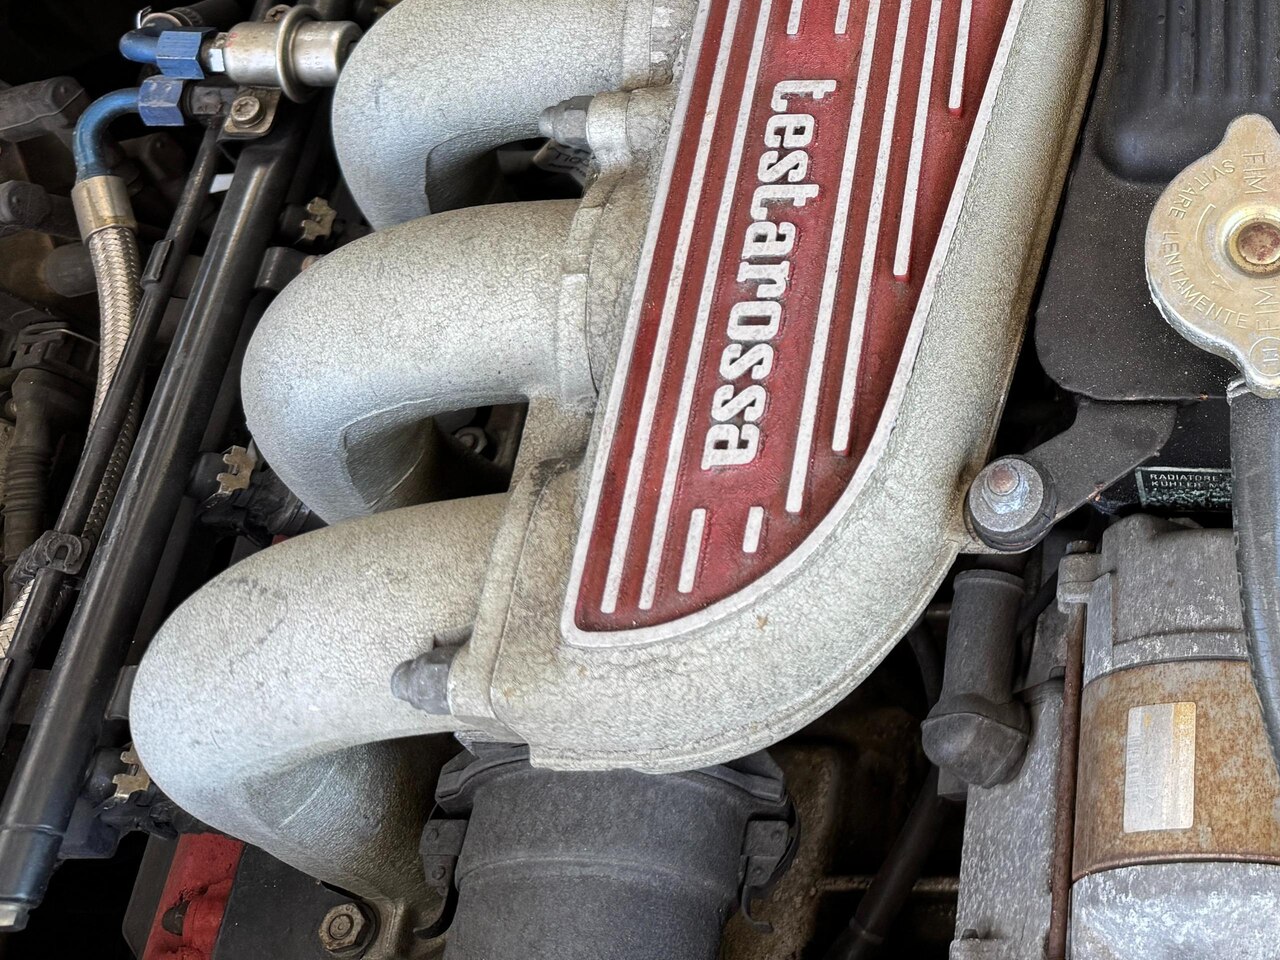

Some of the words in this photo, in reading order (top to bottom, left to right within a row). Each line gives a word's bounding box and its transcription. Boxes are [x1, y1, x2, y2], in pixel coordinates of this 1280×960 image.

[1168, 158, 1236, 220] SVITARE
[1243, 151, 1269, 195] FIM
[701, 78, 838, 471] testarossa
[1161, 230, 1250, 330] LENTAMENTE
[1253, 285, 1280, 332] FIM
[1149, 473, 1217, 482] RADIATORE
